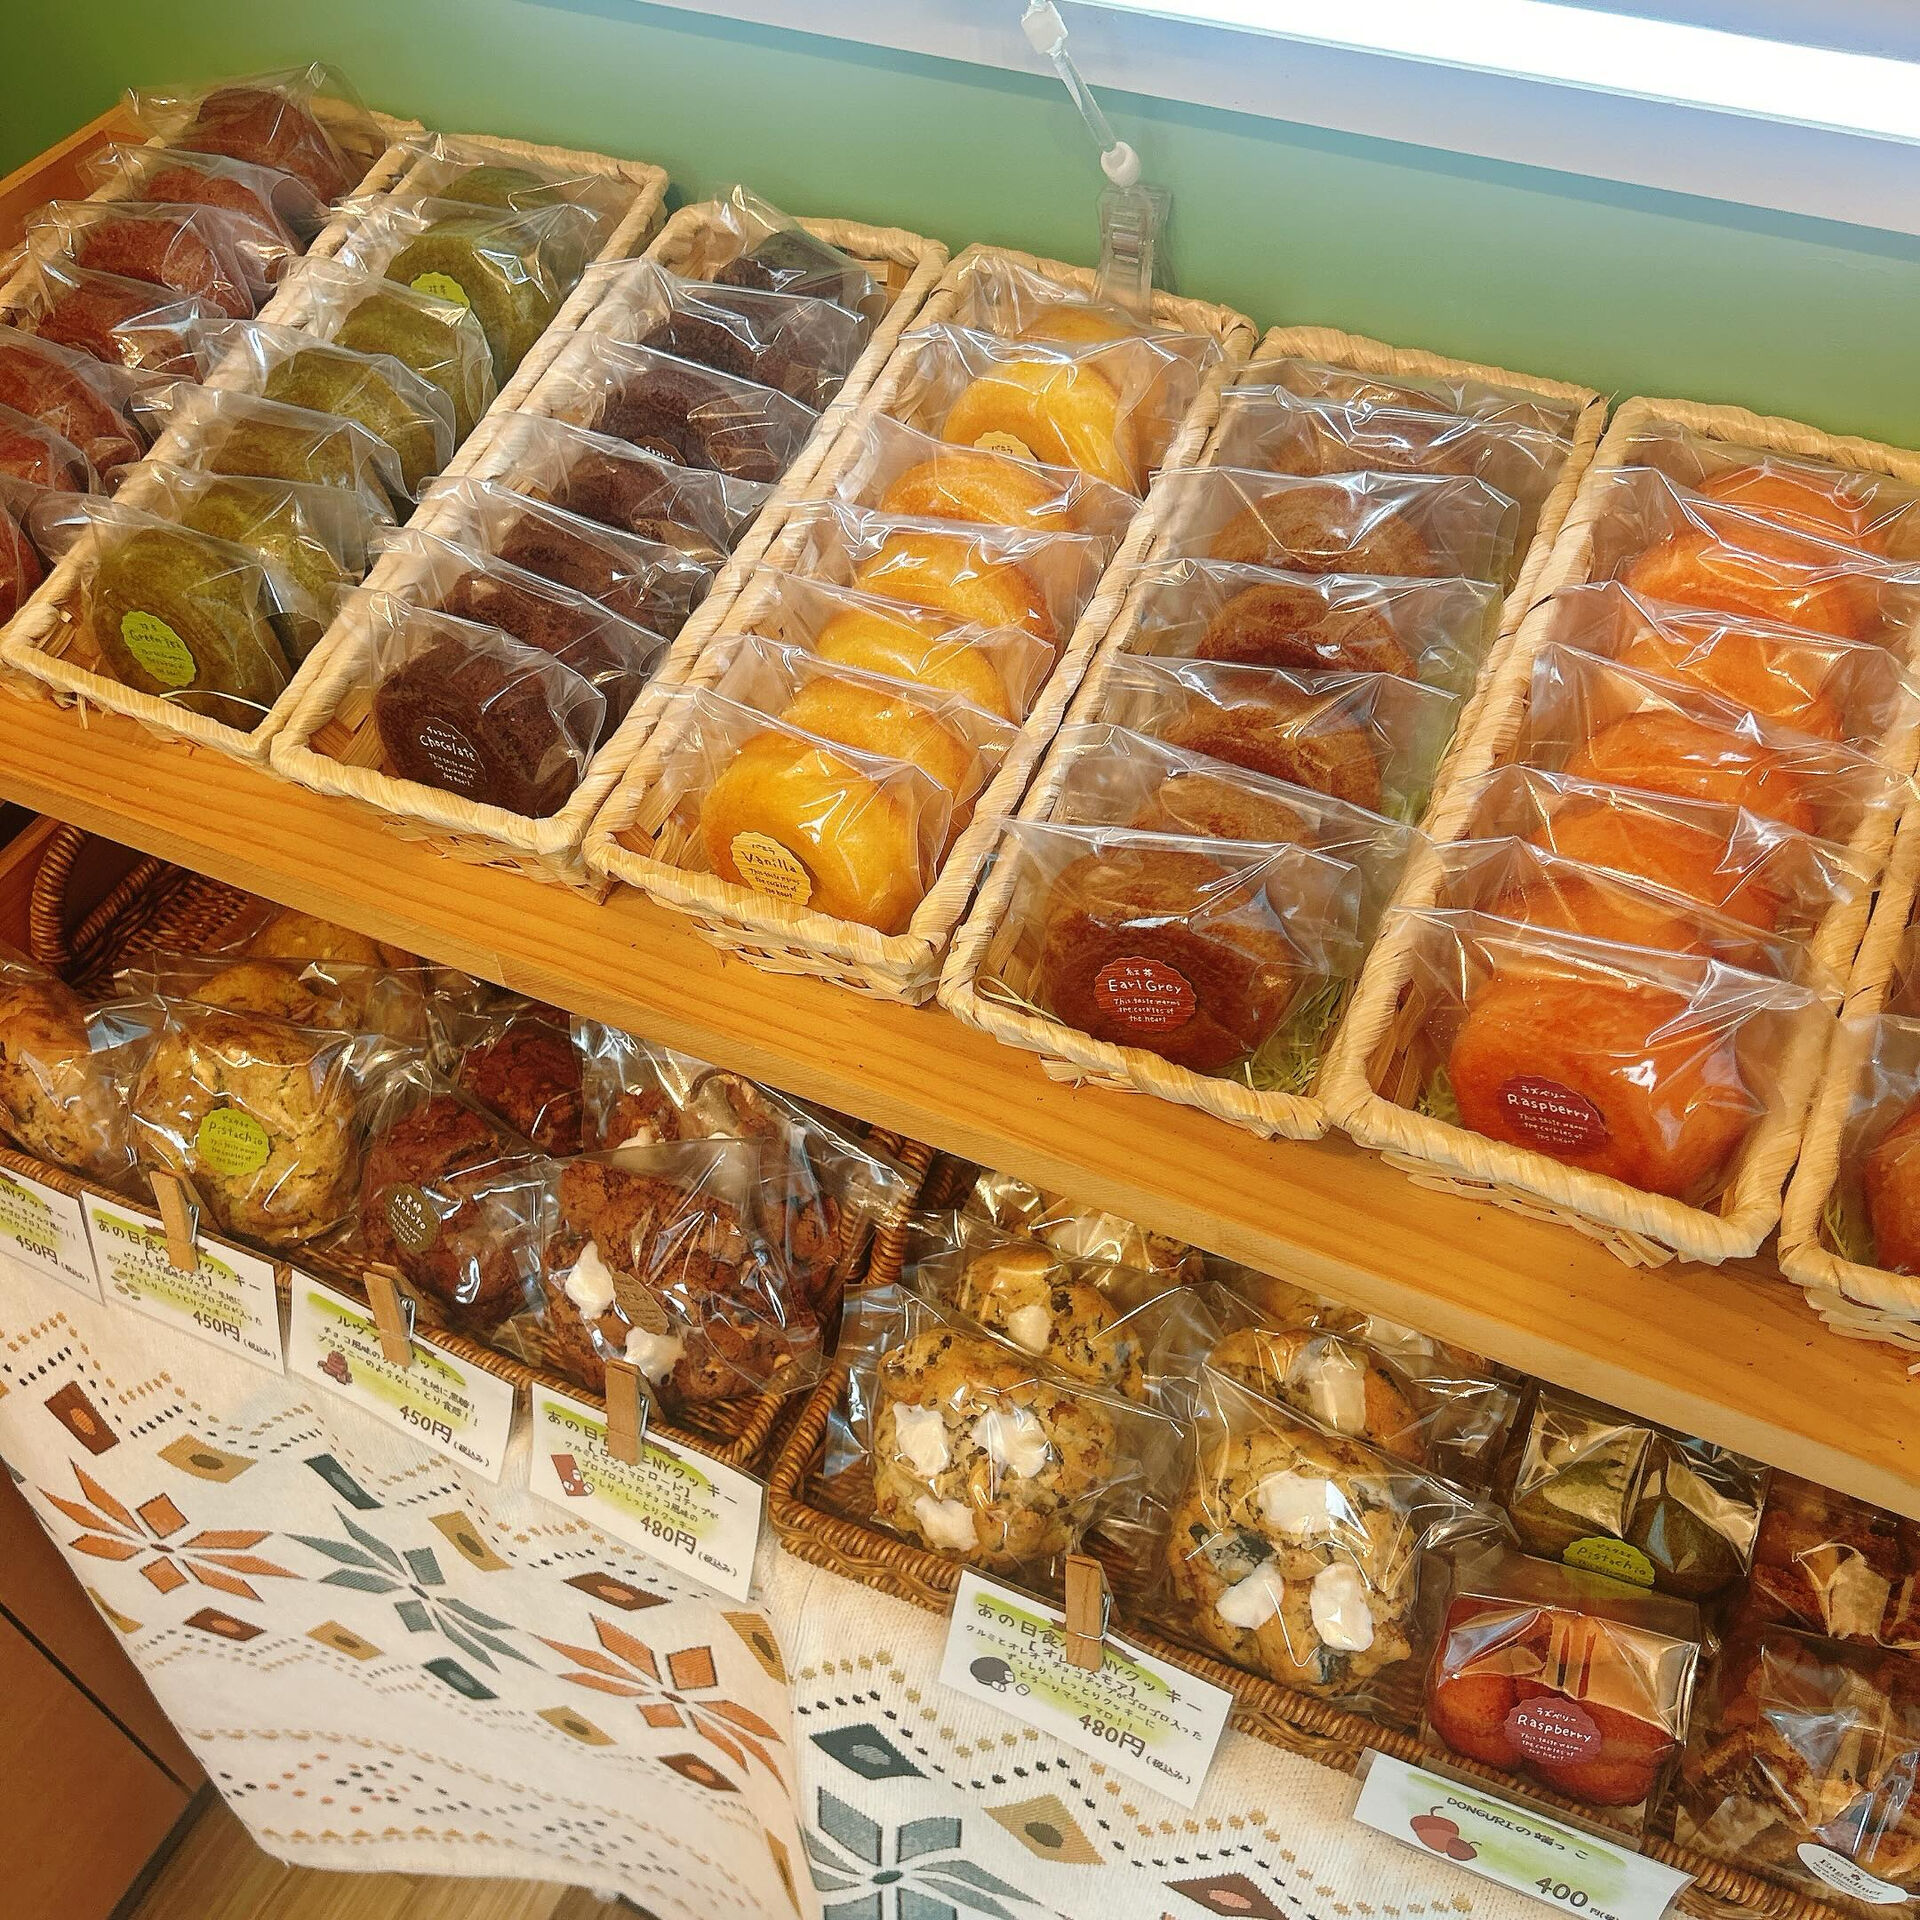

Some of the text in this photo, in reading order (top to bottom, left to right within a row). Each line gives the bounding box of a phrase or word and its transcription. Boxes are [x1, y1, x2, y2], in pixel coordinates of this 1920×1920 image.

[419, 734, 476, 762] Chocolate
[741, 850, 797, 874] Vanilla
[752, 843, 775, 856] バニラ
[1108, 979, 1182, 995] Earl Grey
[1521, 1085, 1567, 1099] ラズベリー
[1506, 1093, 1590, 1121] Raspberry
[208, 1121, 263, 1146] Pistachio
[16, 1234, 58, 1265] 450円
[192, 1310, 241, 1343] 450円
[400, 1405, 453, 1445] 450円
[640, 1515, 698, 1556] 480円
[1576, 1547, 1647, 1576] Pistachio
[1517, 1714, 1592, 1742] Raspberry
[1537, 1707, 1577, 1722] ラズベリー
[1078, 1713, 1147, 1759] 480円
[1535, 1876, 1589, 1908] 400
